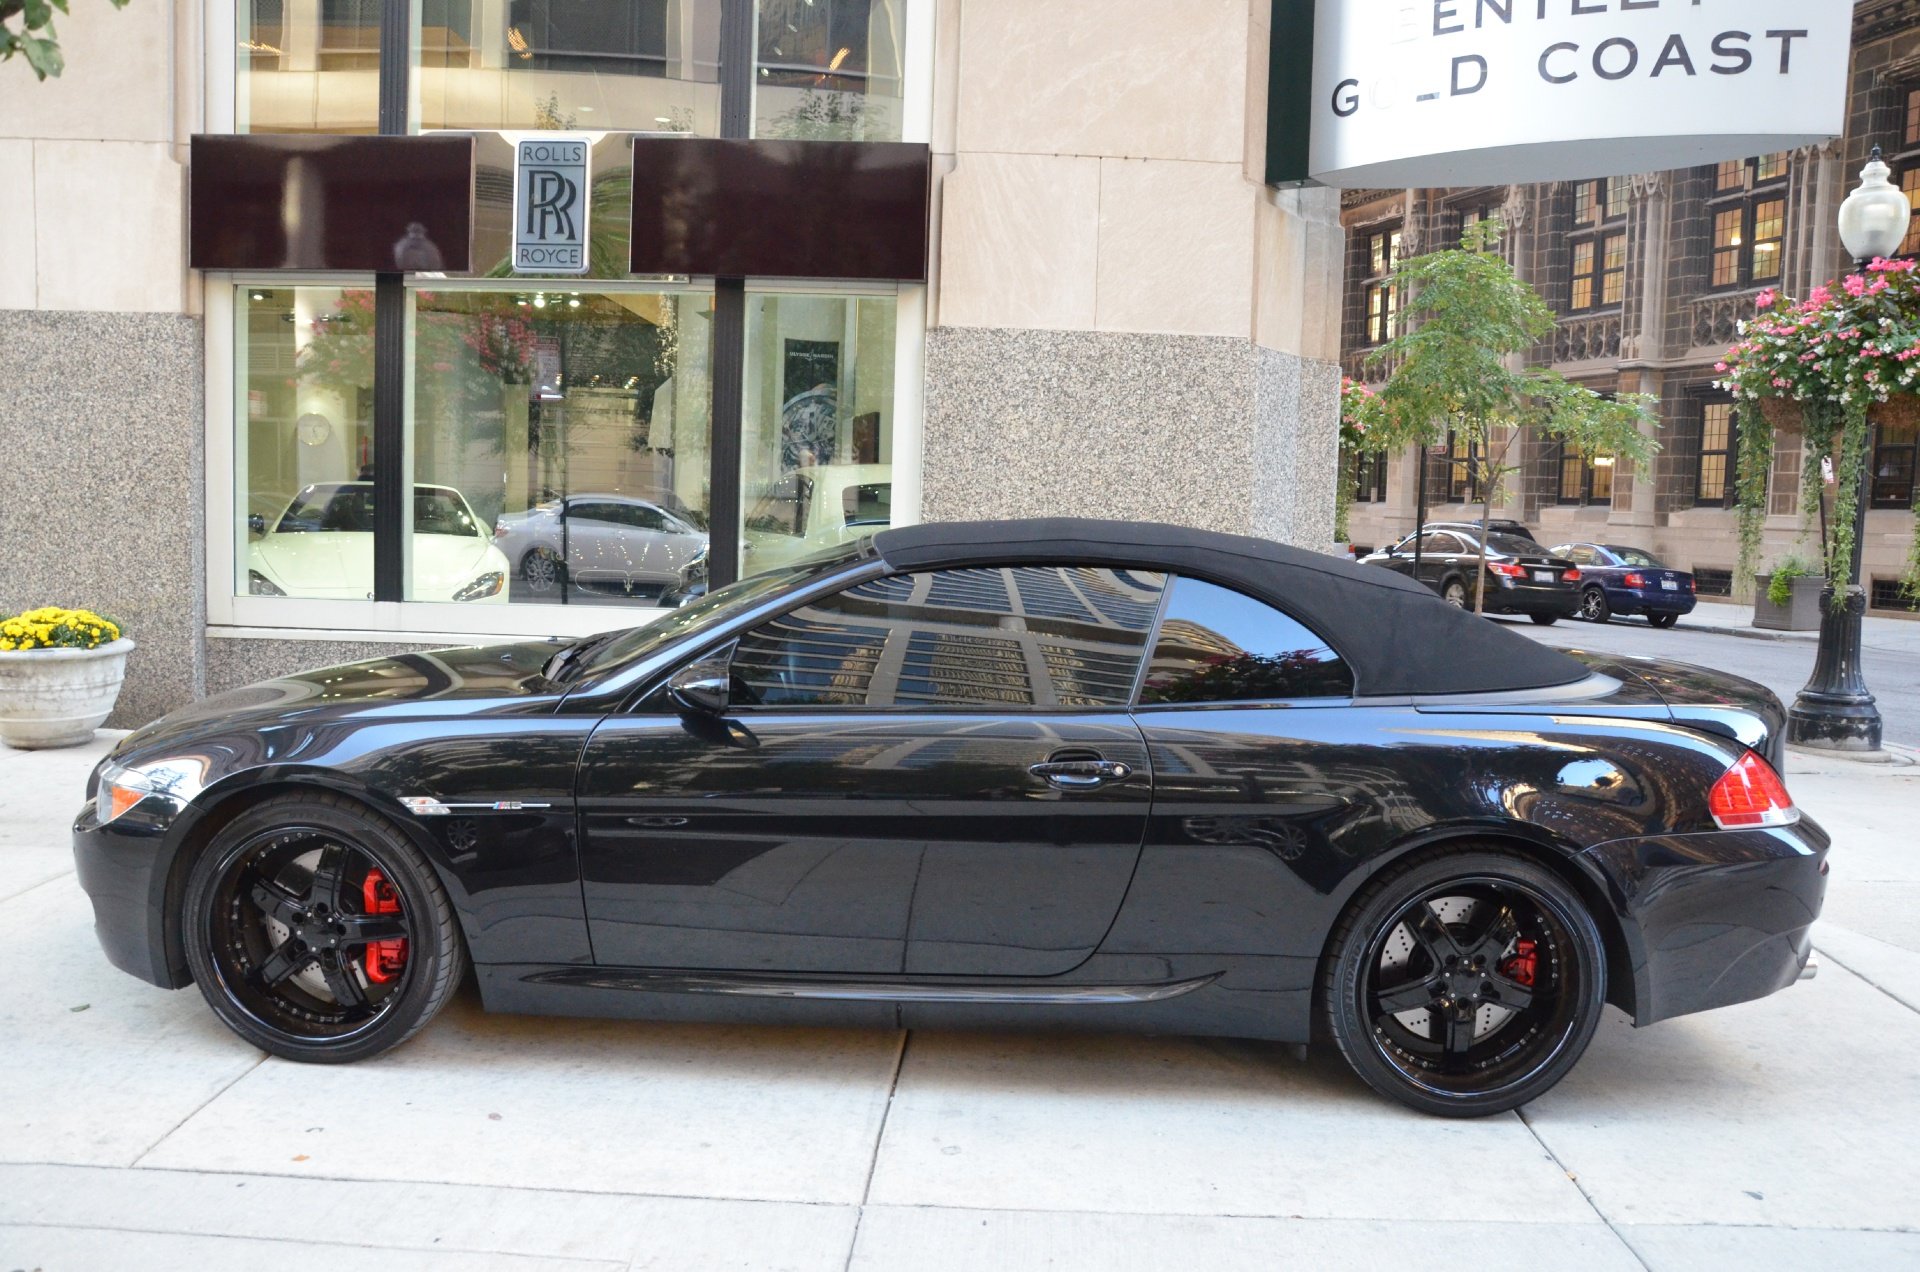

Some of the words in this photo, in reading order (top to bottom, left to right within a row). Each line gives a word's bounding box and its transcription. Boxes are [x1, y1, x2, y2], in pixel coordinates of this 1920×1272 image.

[1331, 54, 1488, 118] GD
[1537, 29, 1808, 84] COAST
[523, 146, 581, 162] ROLLS
[520, 248, 579, 264] ROYCE
